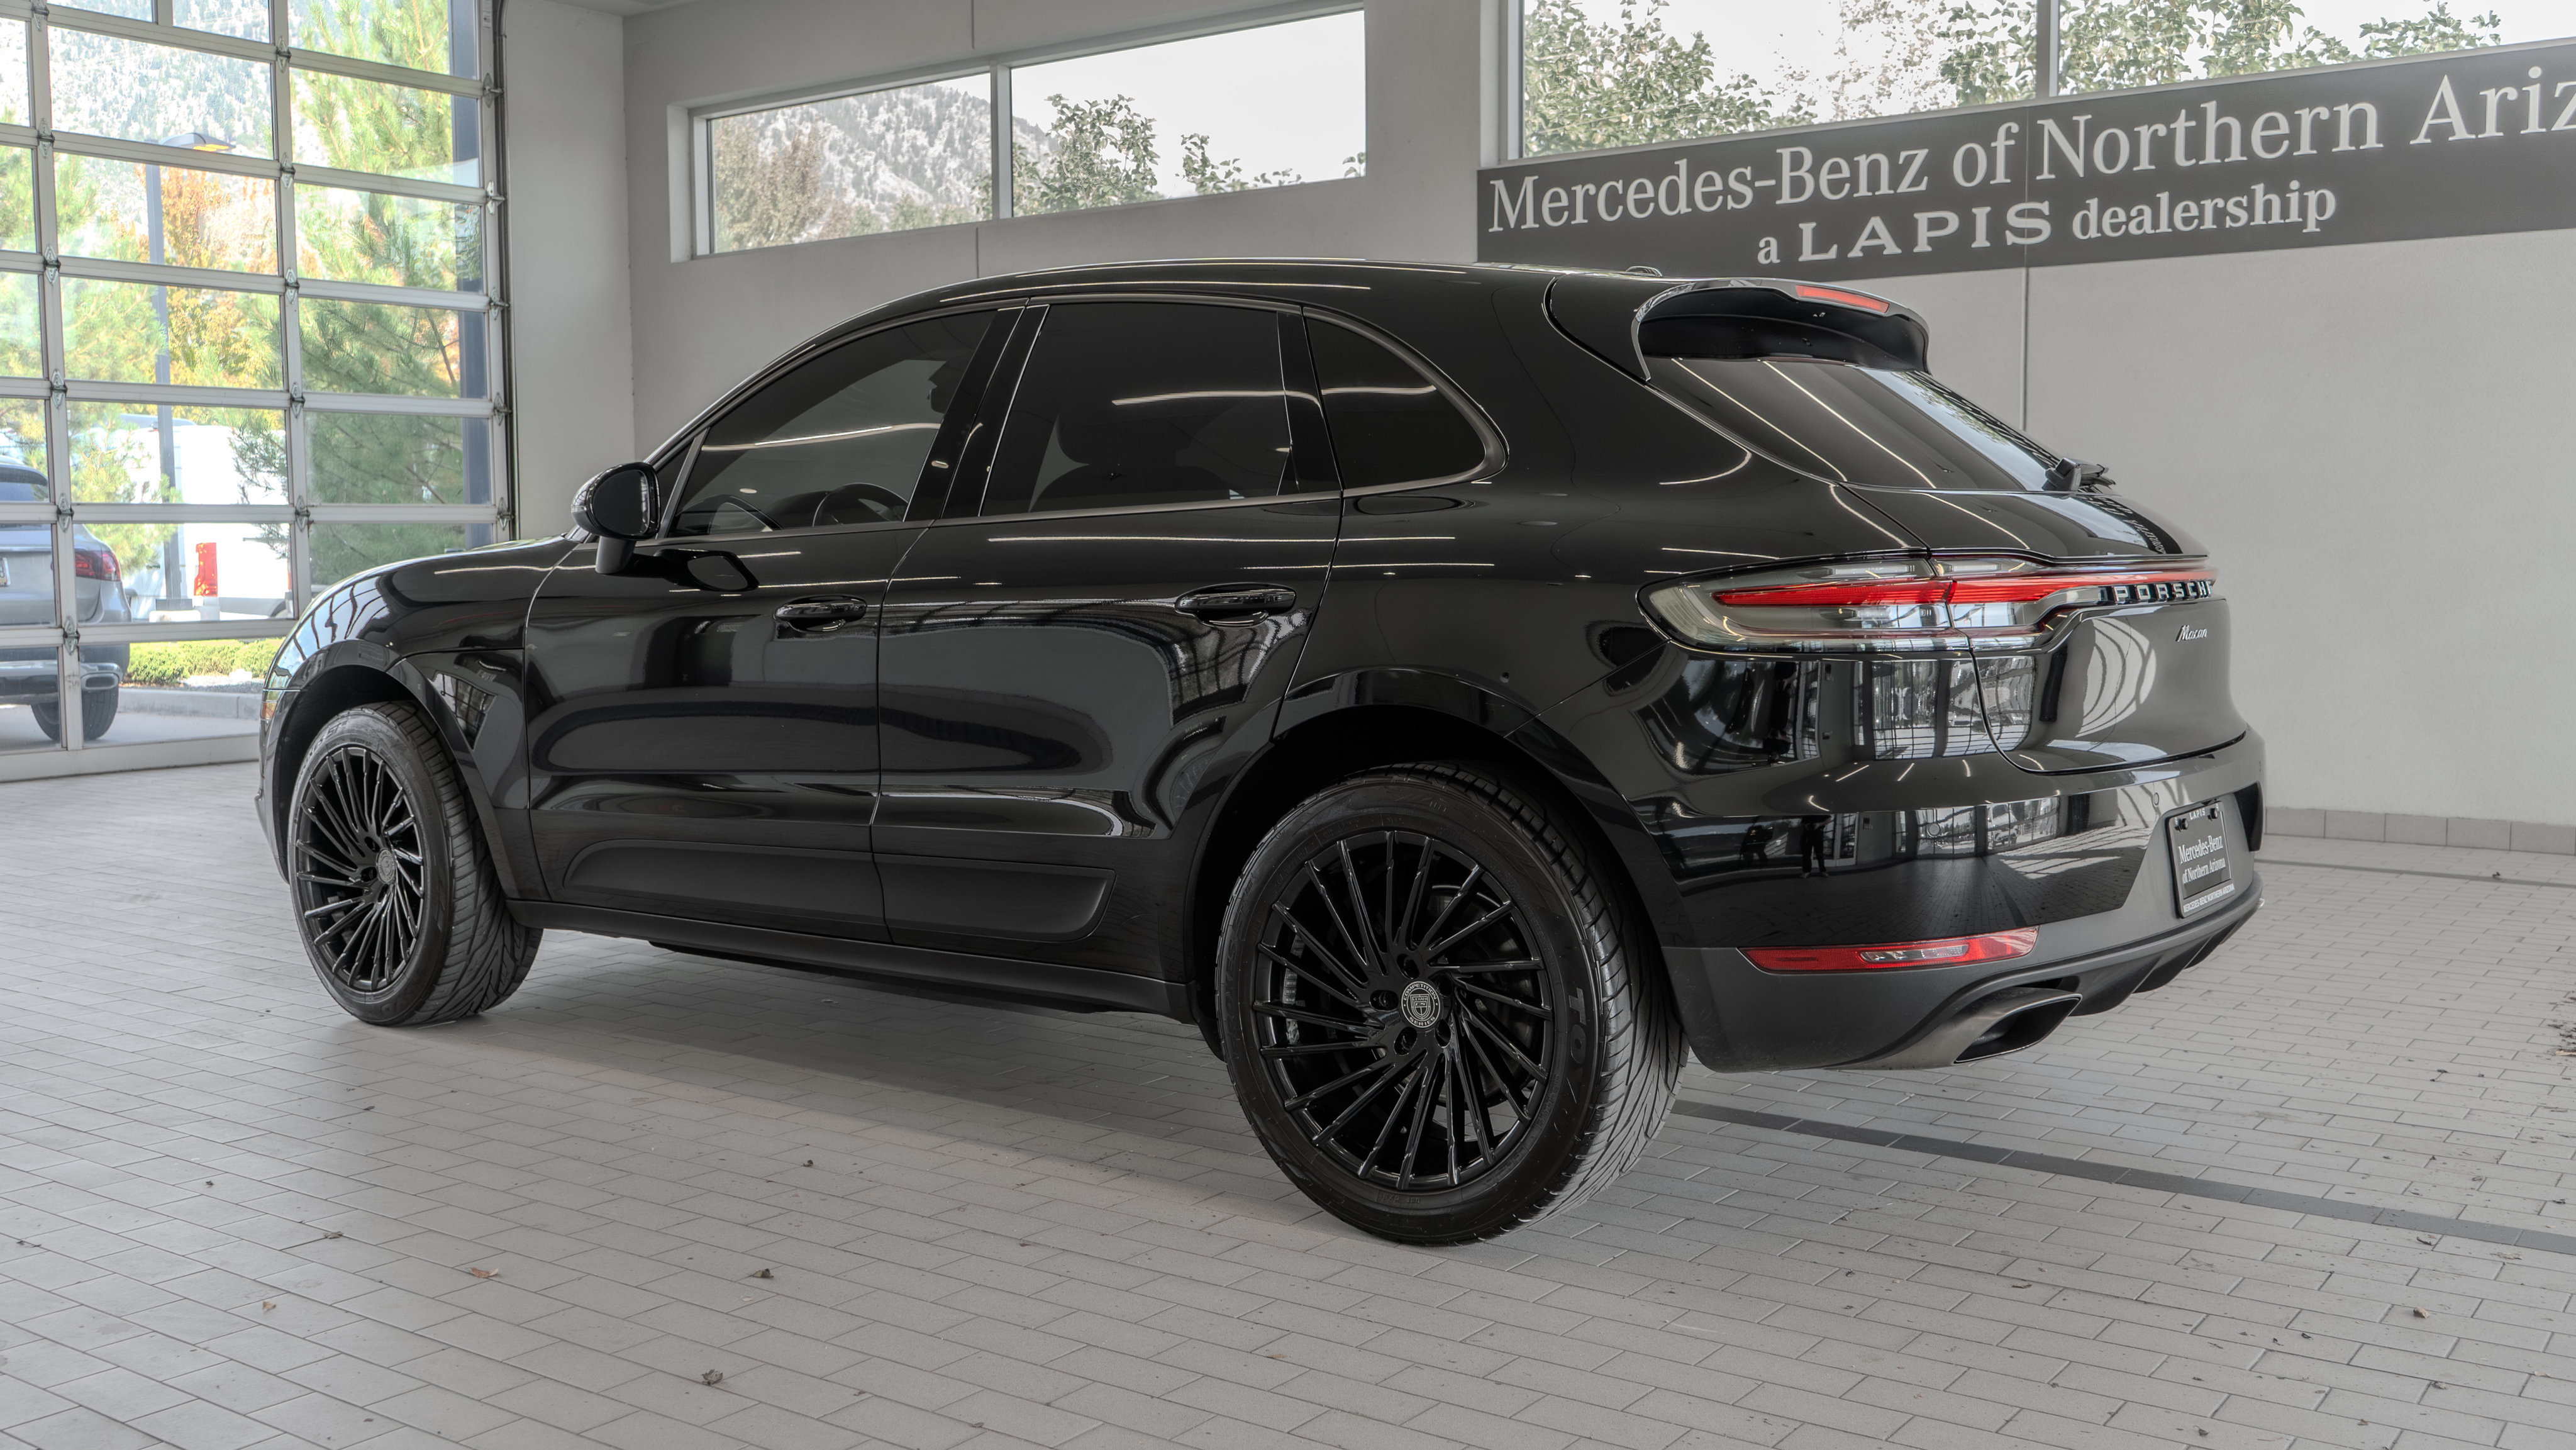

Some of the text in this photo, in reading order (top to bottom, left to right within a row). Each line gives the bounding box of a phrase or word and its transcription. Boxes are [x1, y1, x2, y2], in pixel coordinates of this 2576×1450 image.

[1488, 146, 1929, 233] Mercedes-Benz
[1952, 121, 2020, 187] of
[2035, 96, 2385, 181] Northern
[1757, 179, 2337, 264] a LAPIS dealership
[2175, 625, 2207, 642] Macan
[2189, 808, 2206, 820] LAPIS
[2178, 835, 2224, 865] Mercedes-Benz
[2182, 857, 2226, 884] of Northern Arizona
[2183, 896, 2207, 913] MERCEDES-BENZ
[1403, 983, 1437, 1000] COMPETITION
[1409, 1017, 1435, 1026] SERIES
